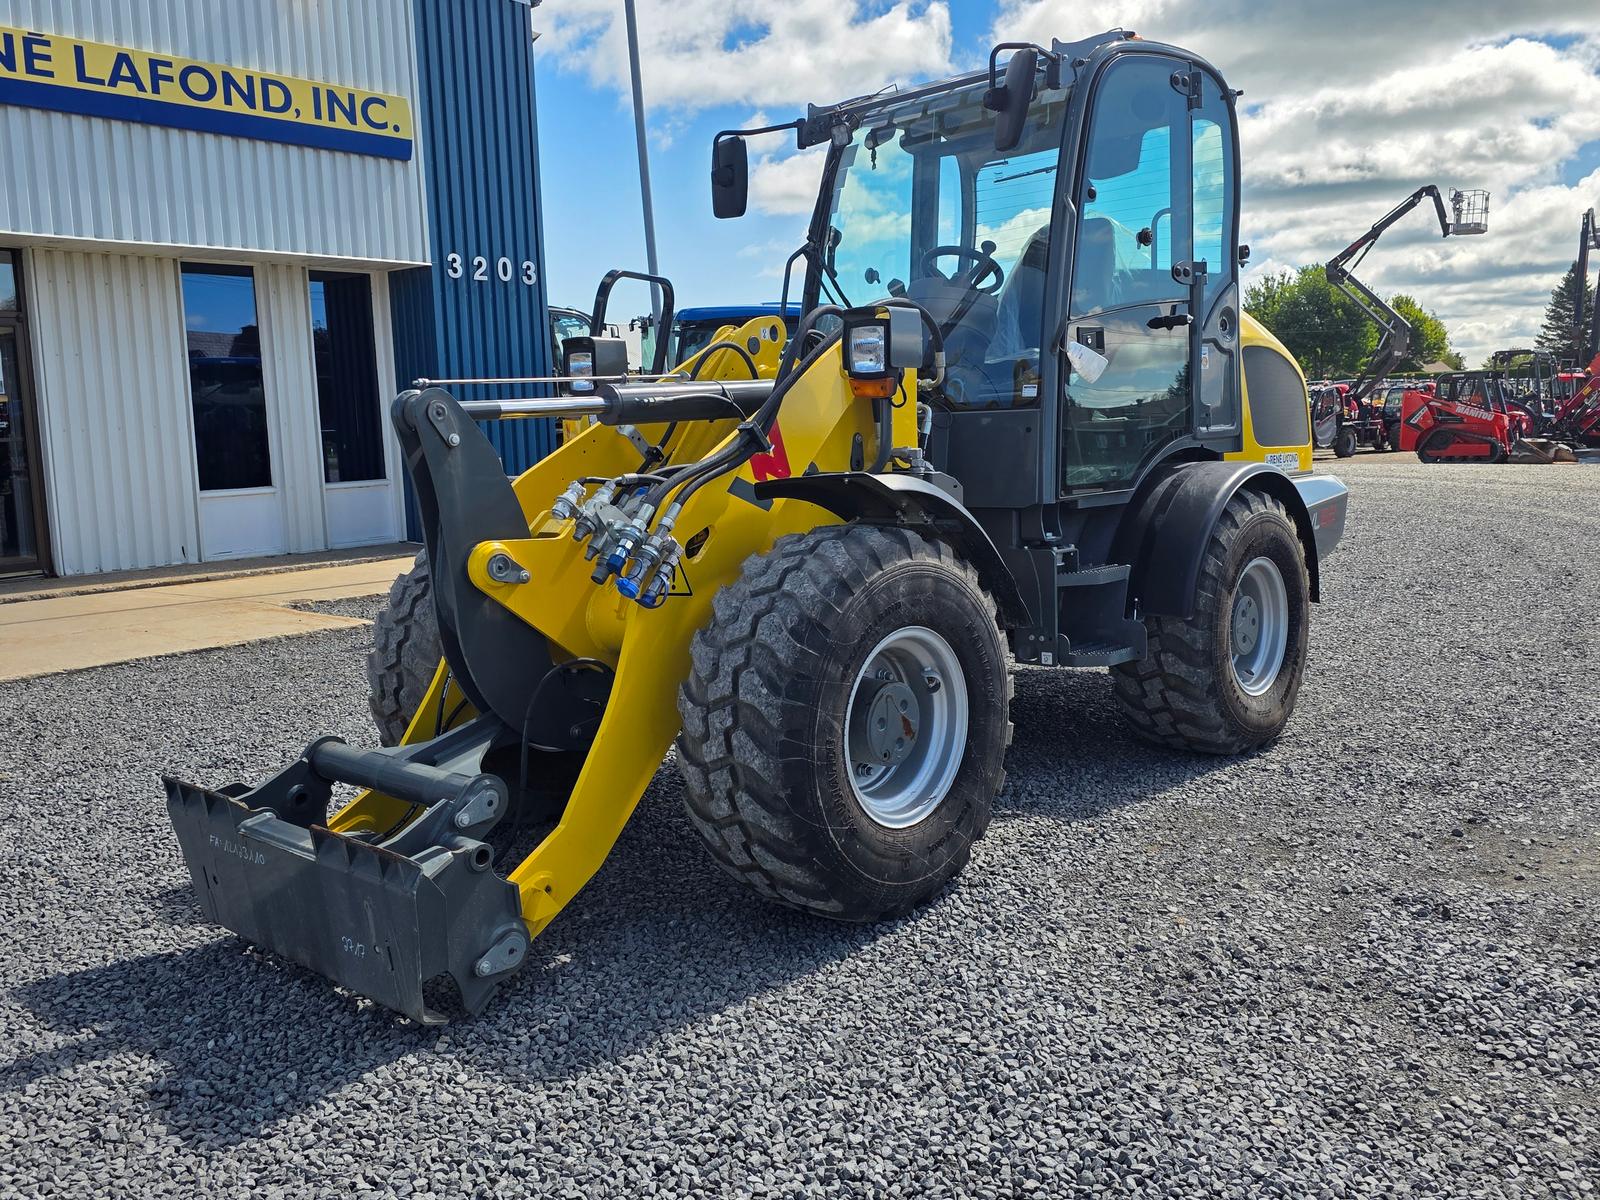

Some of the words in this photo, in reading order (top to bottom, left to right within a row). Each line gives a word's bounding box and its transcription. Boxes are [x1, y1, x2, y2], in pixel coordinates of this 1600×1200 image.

[73, 44, 301, 119] LAFOND,
[312, 86, 401, 133] INC.
[447, 253, 537, 286] 3203
[1455, 405, 1495, 422] MANITOU
